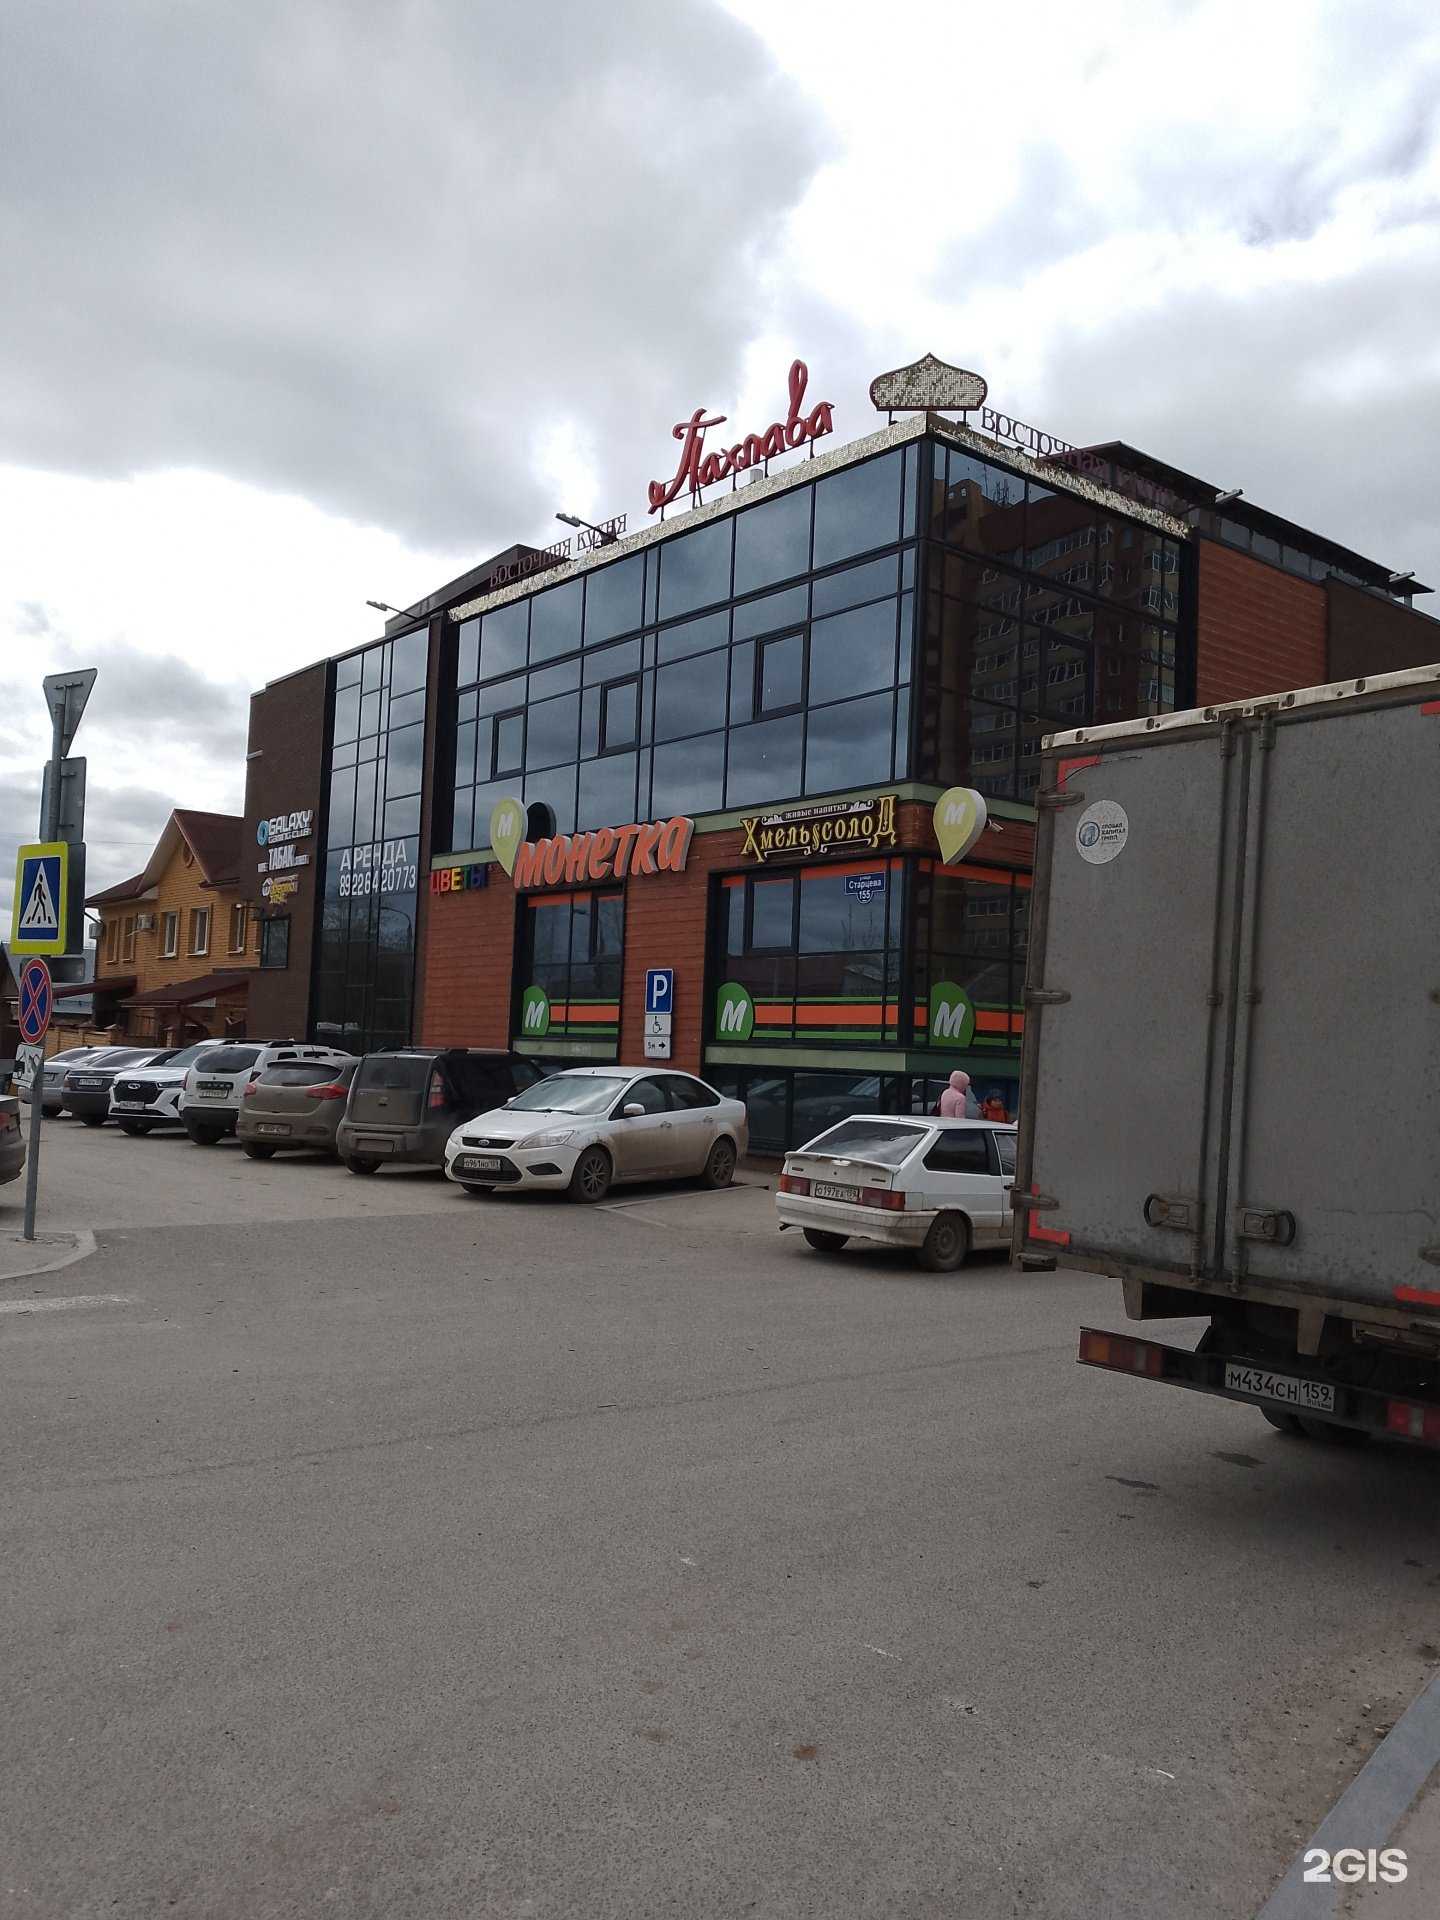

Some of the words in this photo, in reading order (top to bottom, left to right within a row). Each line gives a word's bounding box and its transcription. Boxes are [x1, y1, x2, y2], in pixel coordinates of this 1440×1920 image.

[648, 359, 835, 515] Пахлава
[268, 809, 313, 836] GALAXY
[340, 839, 407, 872] АРЕНДА
[430, 864, 489, 897] ЦВЕТЫ
[849, 879, 882, 891] Старцева
[859, 889, 871, 900] 155
